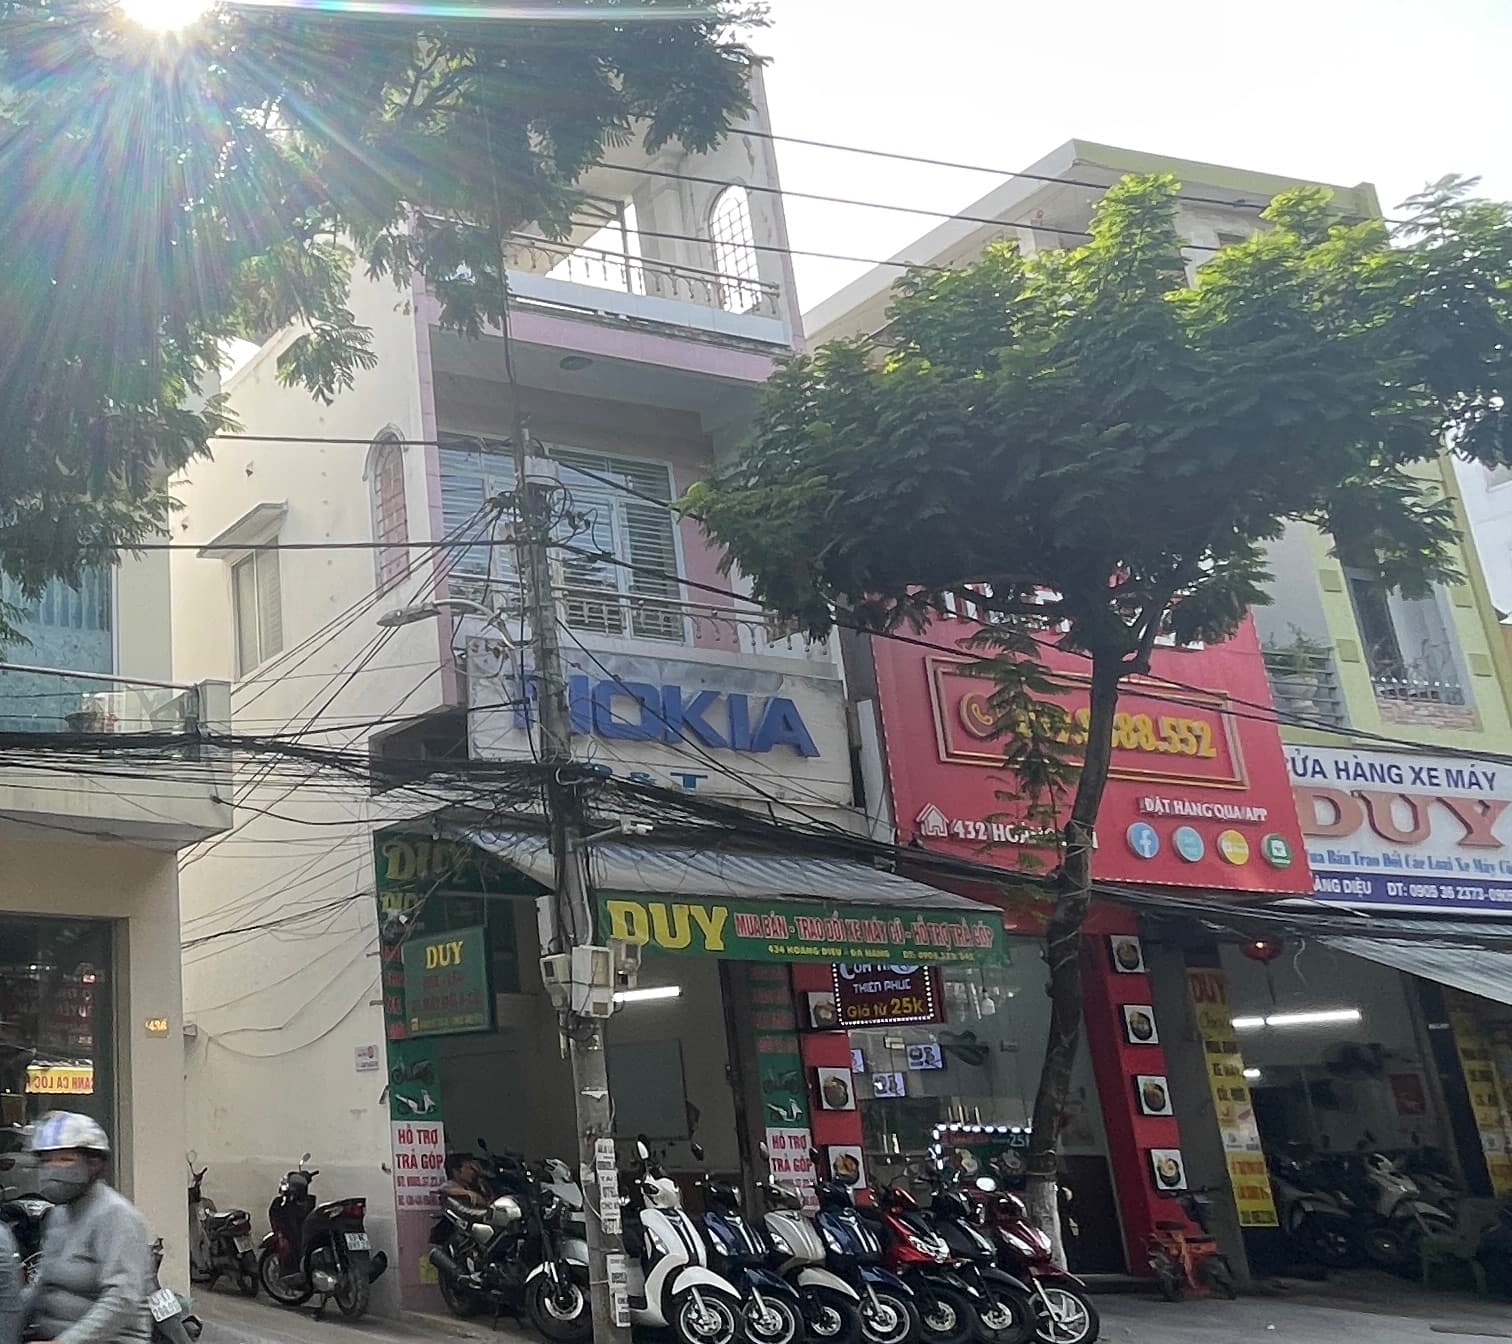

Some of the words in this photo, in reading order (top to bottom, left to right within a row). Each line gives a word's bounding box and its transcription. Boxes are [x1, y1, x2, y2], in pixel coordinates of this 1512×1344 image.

[513, 669, 821, 758] NOKIA
[1285, 748, 1327, 779] ỬA
[1335, 756, 1403, 784] HÀNG
[1408, 766, 1441, 787] XE
[1445, 764, 1496, 791] MÁY
[1173, 798, 1211, 819] HÀNG
[1213, 804, 1242, 820] QUA
[1245, 806, 1267, 821] APP
[1293, 784, 1512, 848] DUY
[953, 819, 987, 840] 432
[1314, 874, 1341, 893] ÀNG
[1342, 877, 1372, 897] DIỆU
[606, 900, 728, 951] DUY
[734, 912, 762, 938] MUA
[762, 910, 788, 939] BÁN
[794, 916, 825, 941] TRAO
[425, 941, 463, 969] DUY
[890, 996, 924, 1015] 25k
[416, 1127, 438, 1148] TRỢ
[396, 1148, 418, 1169] TRẢ
[420, 1151, 444, 1169] GÓP
